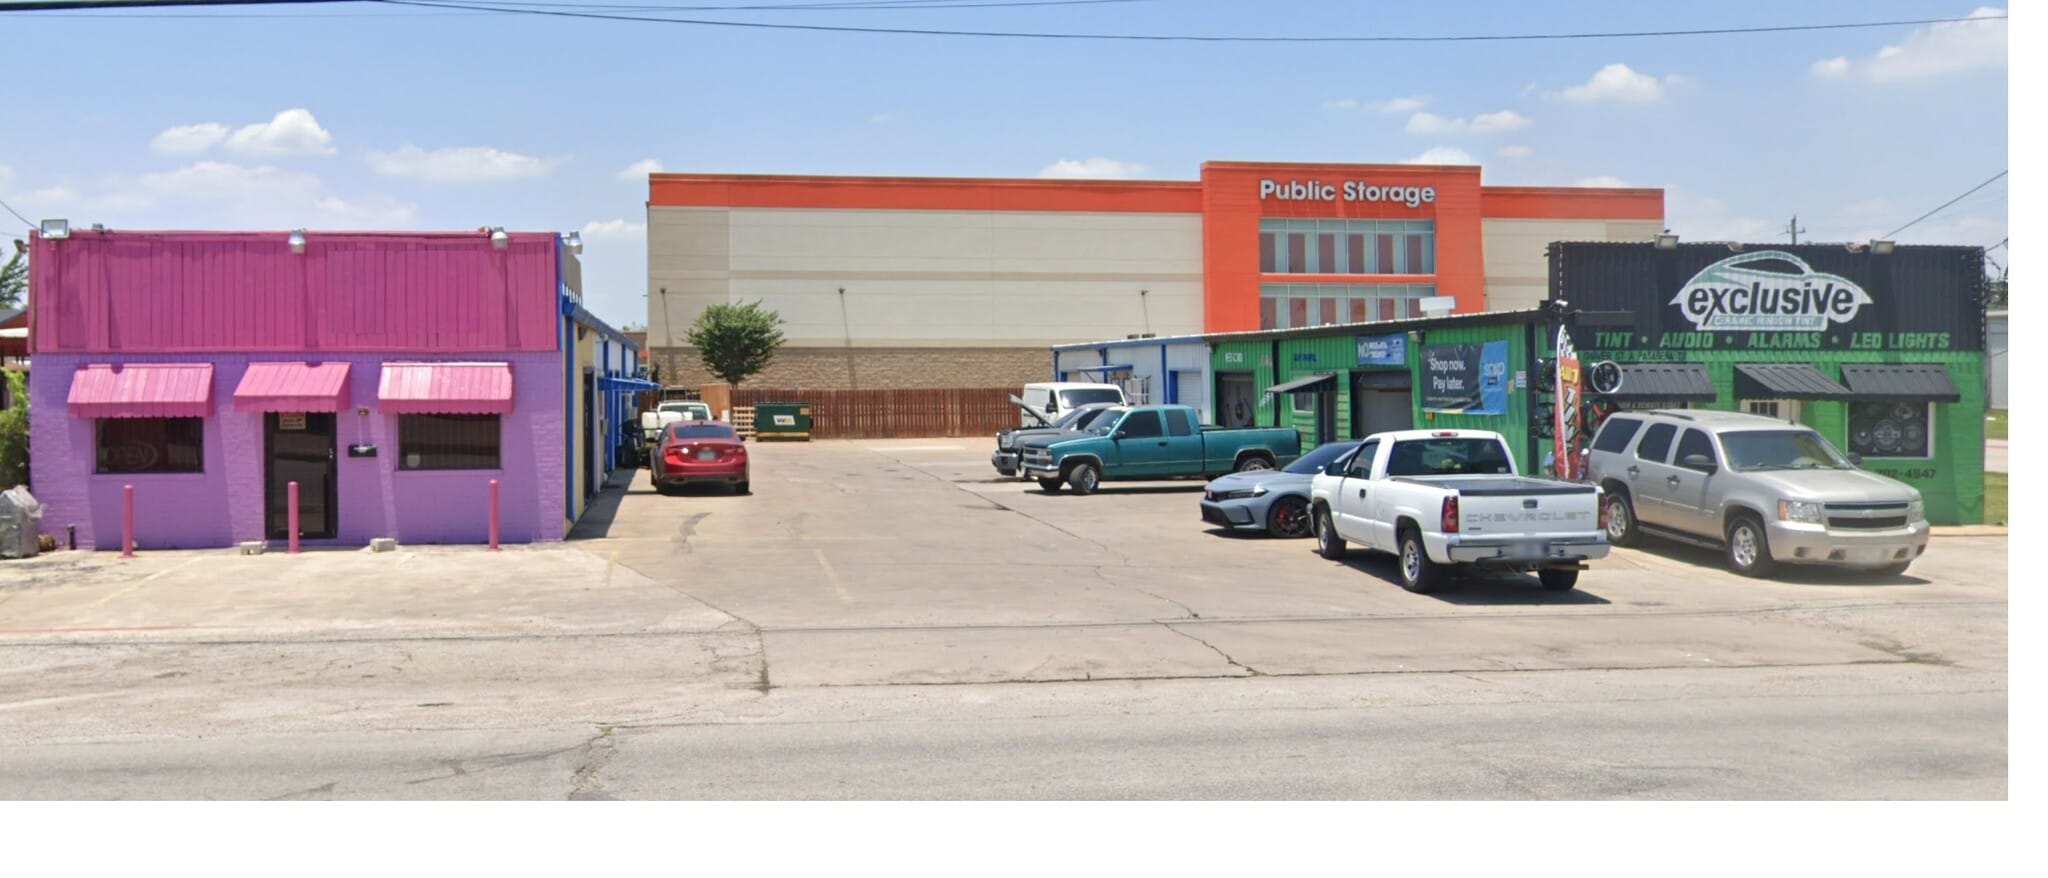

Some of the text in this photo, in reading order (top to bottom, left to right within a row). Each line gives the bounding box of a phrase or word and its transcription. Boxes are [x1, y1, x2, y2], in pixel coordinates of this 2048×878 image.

[1260, 179, 1436, 208] Public Storage
[1688, 281, 1854, 327] exclusive
[1713, 317, 1753, 326] CERAMIC
[1795, 317, 1816, 326] TINT
[1595, 332, 1950, 348] TINT AUDIO ALARMS LED LIGHTS
[1430, 357, 1466, 374] Shop now.
[1433, 376, 1465, 392] Pay later.
[1465, 511, 1590, 523] CHEVROLET
